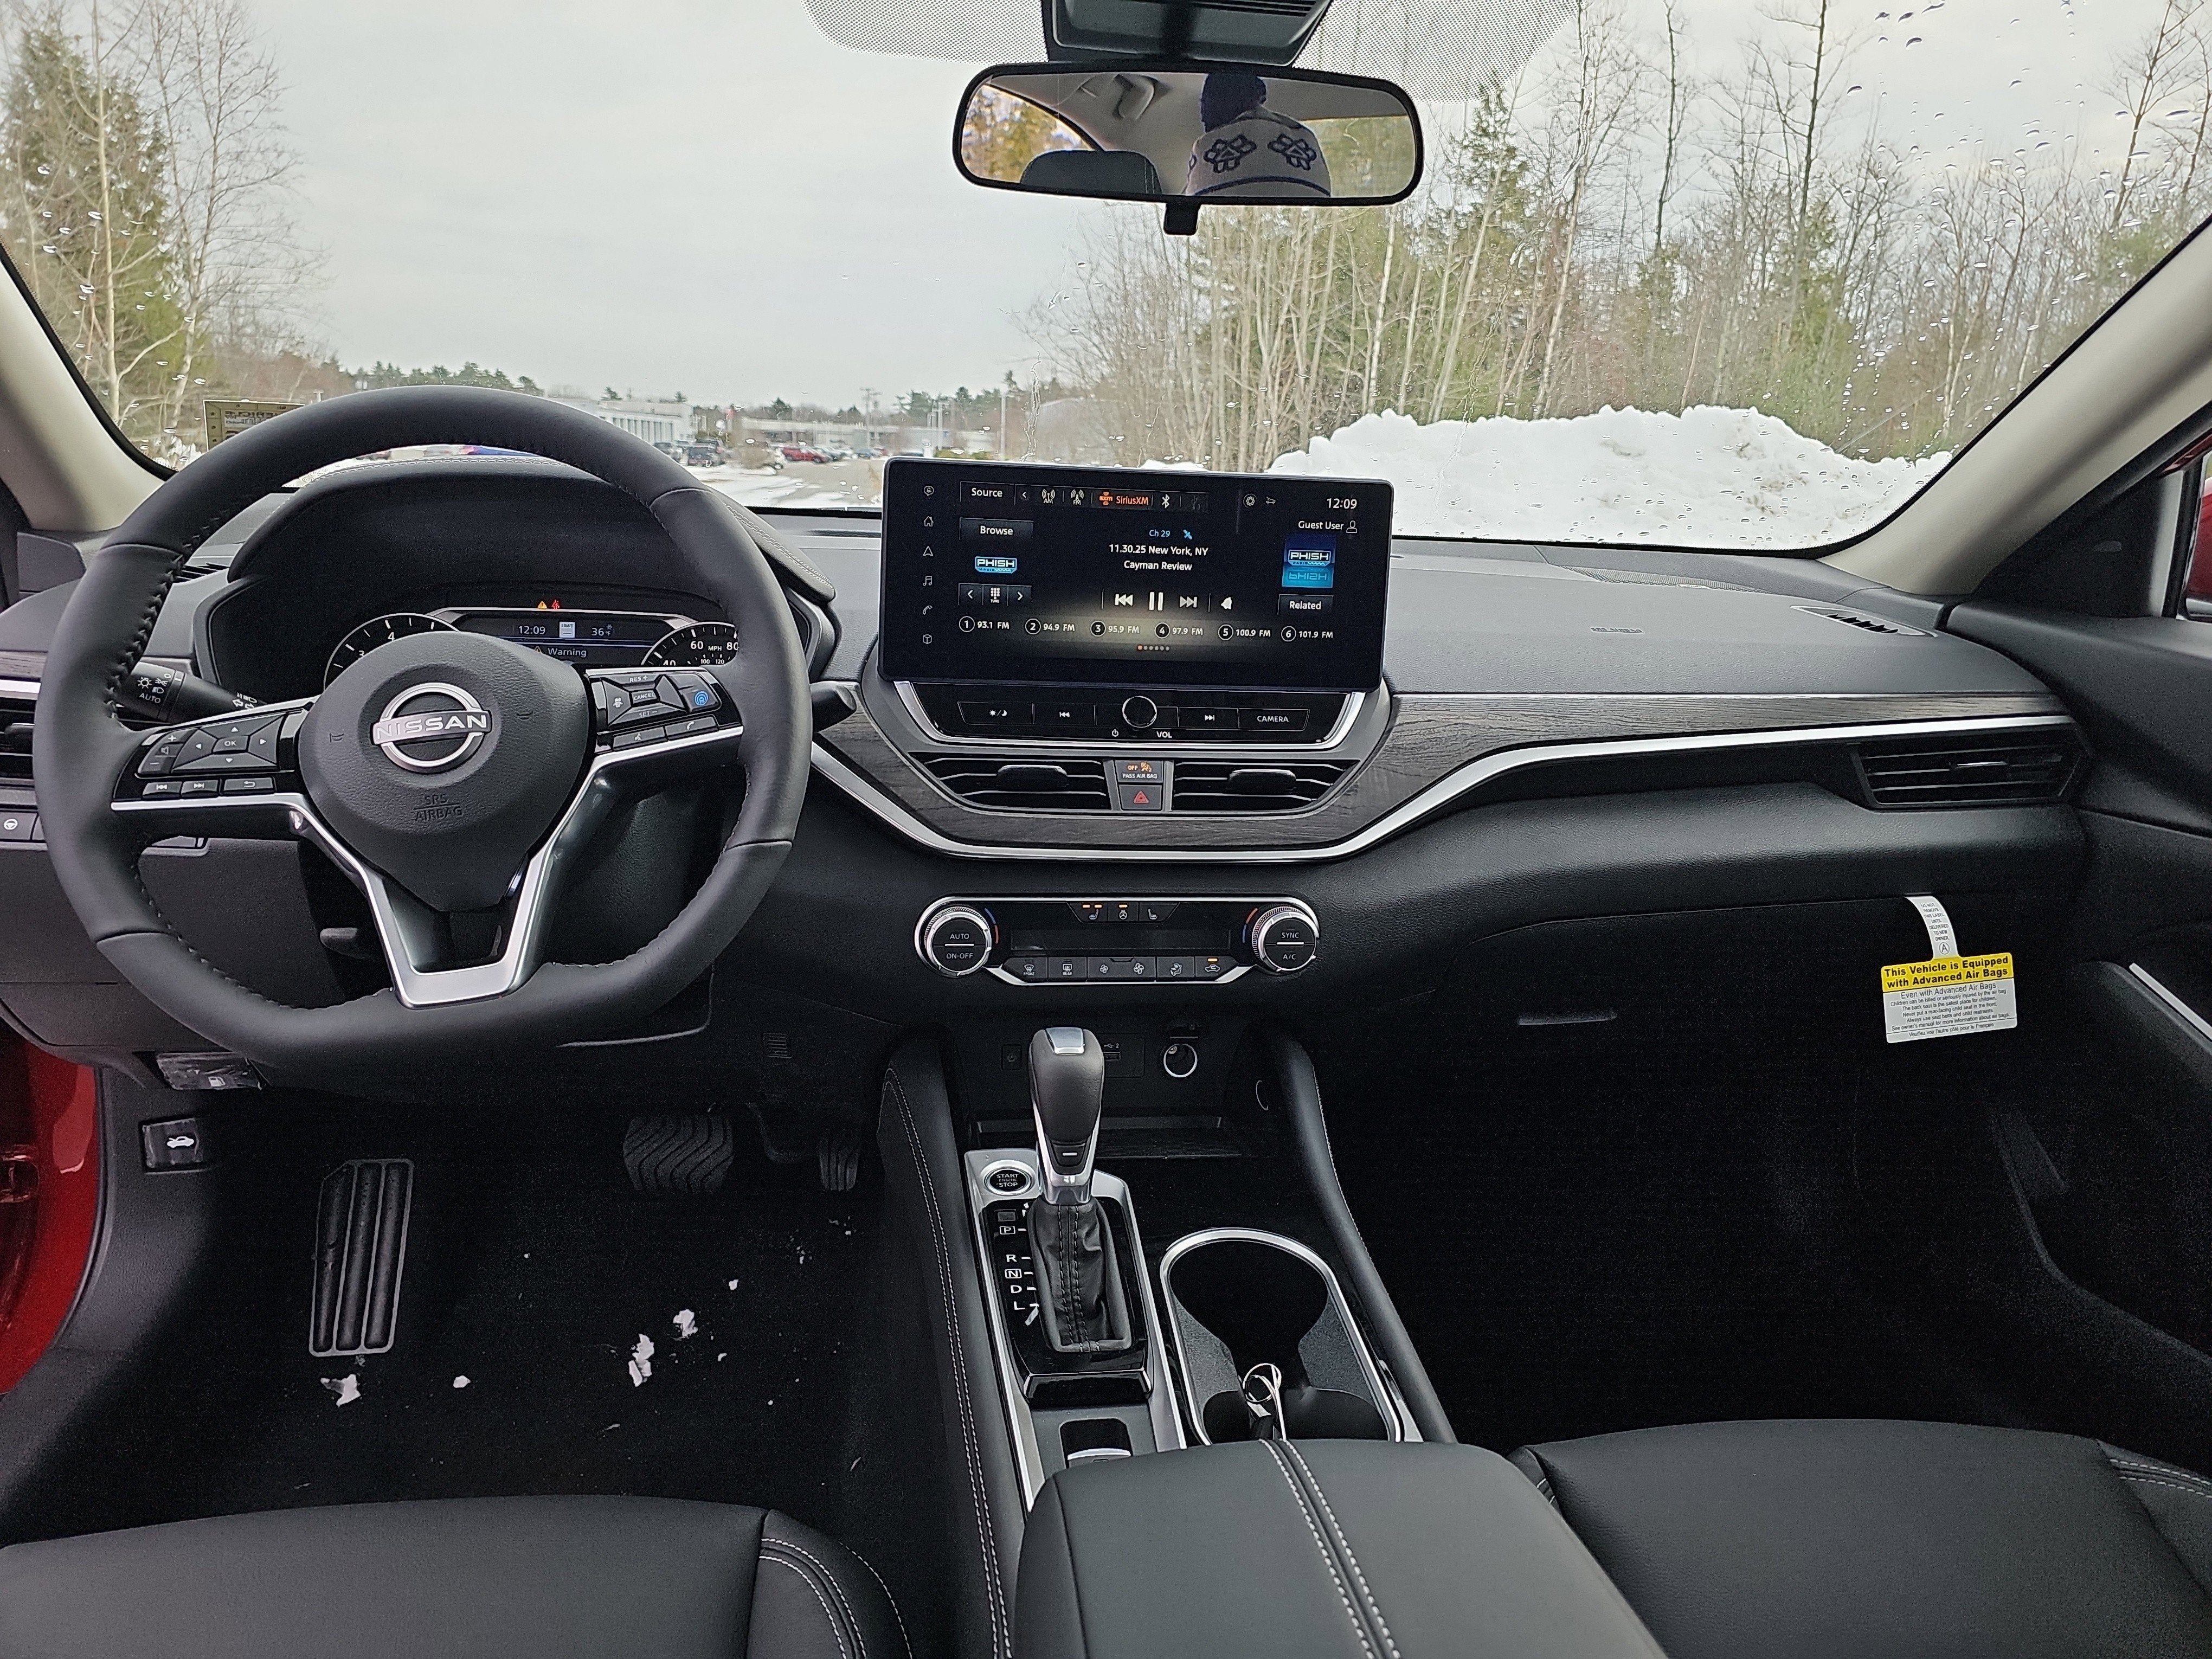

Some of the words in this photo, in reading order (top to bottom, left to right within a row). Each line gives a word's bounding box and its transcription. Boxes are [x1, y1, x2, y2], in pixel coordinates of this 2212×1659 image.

[971, 488, 1002, 497] Source
[1116, 496, 1148, 505] SiriusXM
[1326, 498, 1357, 509] 12:09
[1298, 520, 1323, 530] Guest
[1325, 522, 1344, 530] User
[980, 526, 1013, 536] Browse
[1149, 529, 1159, 537] Ch
[1109, 544, 1146, 554] 11.30.25
[1148, 545, 1168, 555] New
[1171, 546, 1193, 557] York,
[1195, 548, 1208, 556] NY
[1290, 552, 1328, 560] PHISH
[977, 558, 1015, 567] PHISH
[1124, 561, 1159, 571] Cayman
[1161, 562, 1192, 571] Review
[1289, 601, 1322, 610] Related
[977, 621, 993, 629] 93.1
[1094, 625, 1101, 633] 3
[1108, 625, 1124, 634] 95.9
[1128, 626, 1139, 634] FM
[518, 626, 546, 634] 12:09
[591, 628, 604, 636] 36
[1159, 626, 1165, 634] 4
[1172, 627, 1188, 635] 97.9
[1191, 627, 1203, 635] FM
[1223, 628, 1229, 636] 5
[1236, 628, 1256, 637] 100.9
[1259, 629, 1270, 638] FM
[1285, 630, 1291, 638] 6
[388, 632, 395, 641] 4
[1298, 631, 1319, 639] 101.9
[1322, 631, 1333, 639] FM
[690, 641, 704, 650] 60
[726, 642, 738, 651] 80
[548, 648, 587, 658] Warning
[139, 693, 160, 703] AUTO
[633, 692, 654, 700] CANCEL
[377, 715, 487, 740] NISSAN
[425, 794, 448, 805] SRS
[413, 807, 464, 823] AIRBAG
[1885, 968, 1906, 977] This
[1909, 963, 1947, 974] Vehicle
[1963, 956, 2008, 969] Equipped
[1887, 978, 1908, 988] with
[1913, 972, 1962, 985] Advanced
[1965, 970, 1979, 979] Air
[1983, 968, 2008, 978] Bags
[1934, 985, 1966, 995] Advanced
[1014, 1301, 1025, 1310] L
